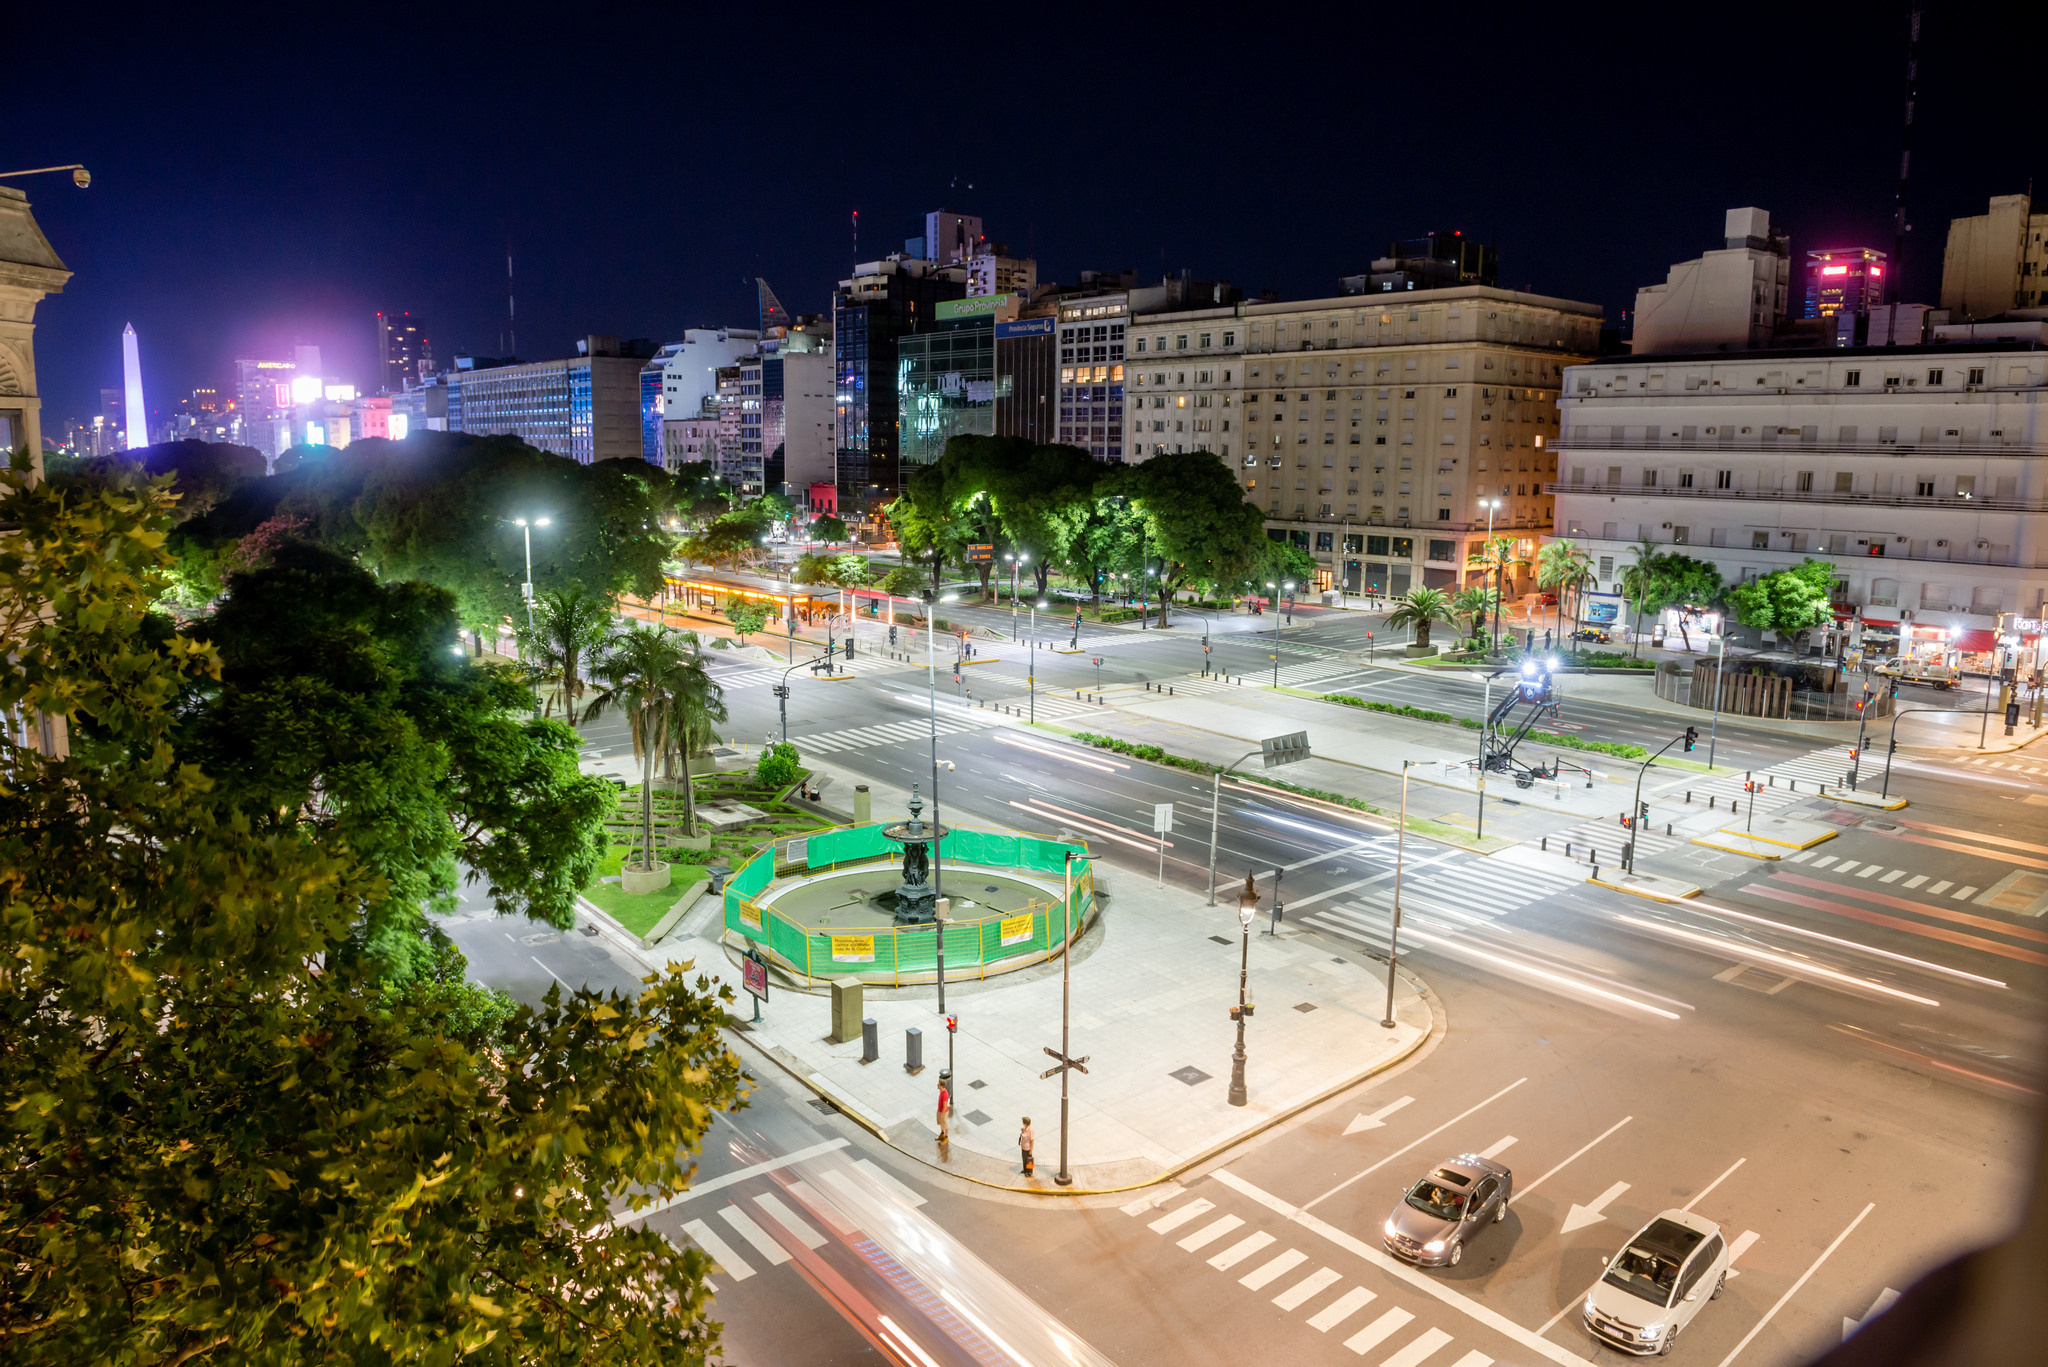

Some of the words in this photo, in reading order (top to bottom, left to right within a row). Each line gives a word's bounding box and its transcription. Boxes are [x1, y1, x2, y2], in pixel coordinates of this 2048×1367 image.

[954, 303, 974, 314] Grupo
[1009, 324, 1026, 332] Provincia
[1027, 323, 1043, 332] Seguros
